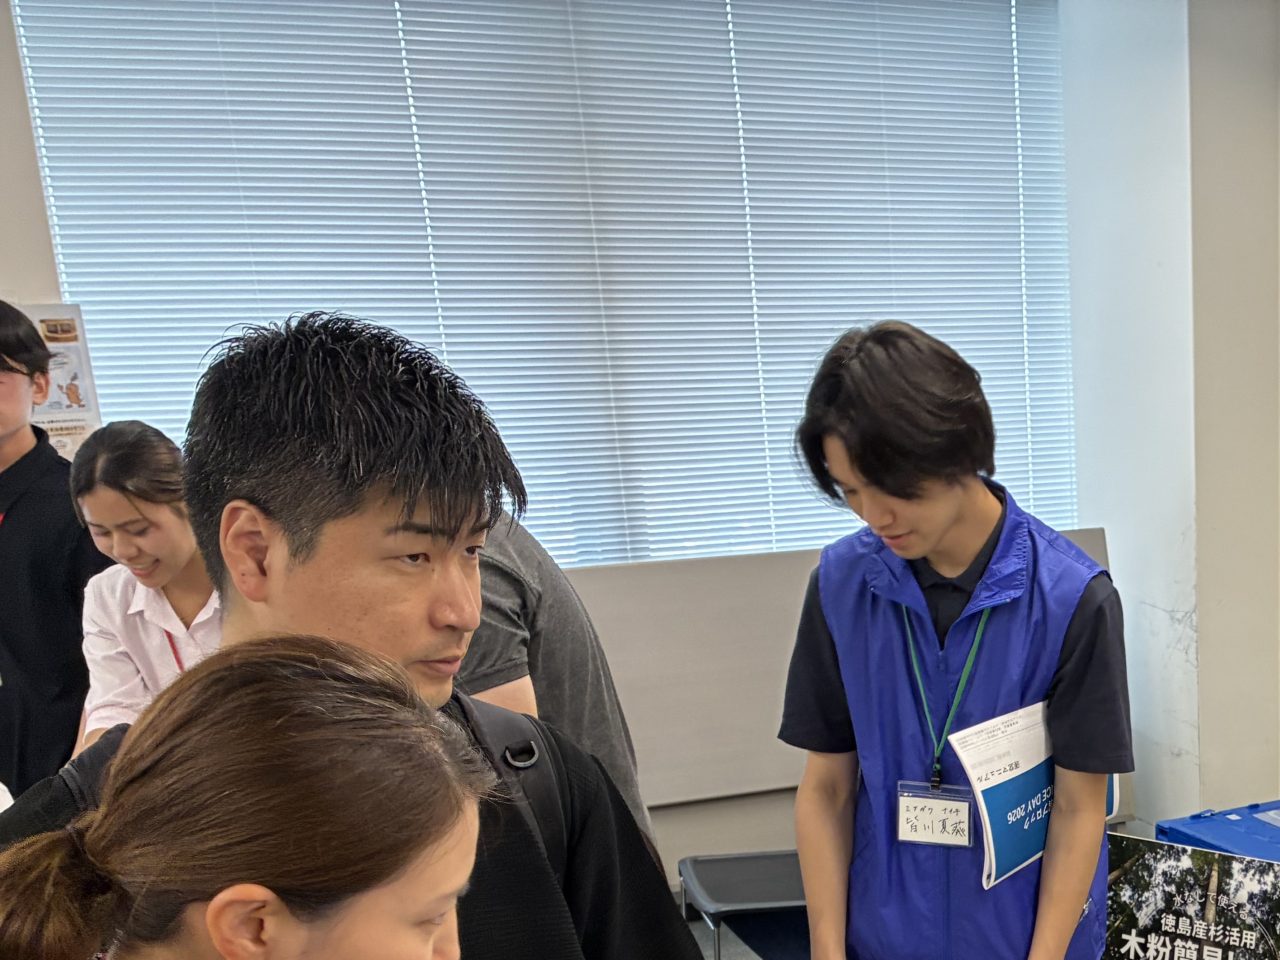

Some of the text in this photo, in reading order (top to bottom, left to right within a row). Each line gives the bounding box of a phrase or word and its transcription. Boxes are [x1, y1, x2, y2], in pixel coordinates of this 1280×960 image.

[1006, 801, 1027, 825] 2026
[1027, 794, 1042, 812] DAY
[1172, 890, 1249, 920] 水なしで使える
[1160, 911, 1256, 949] 徳島産杉活用
